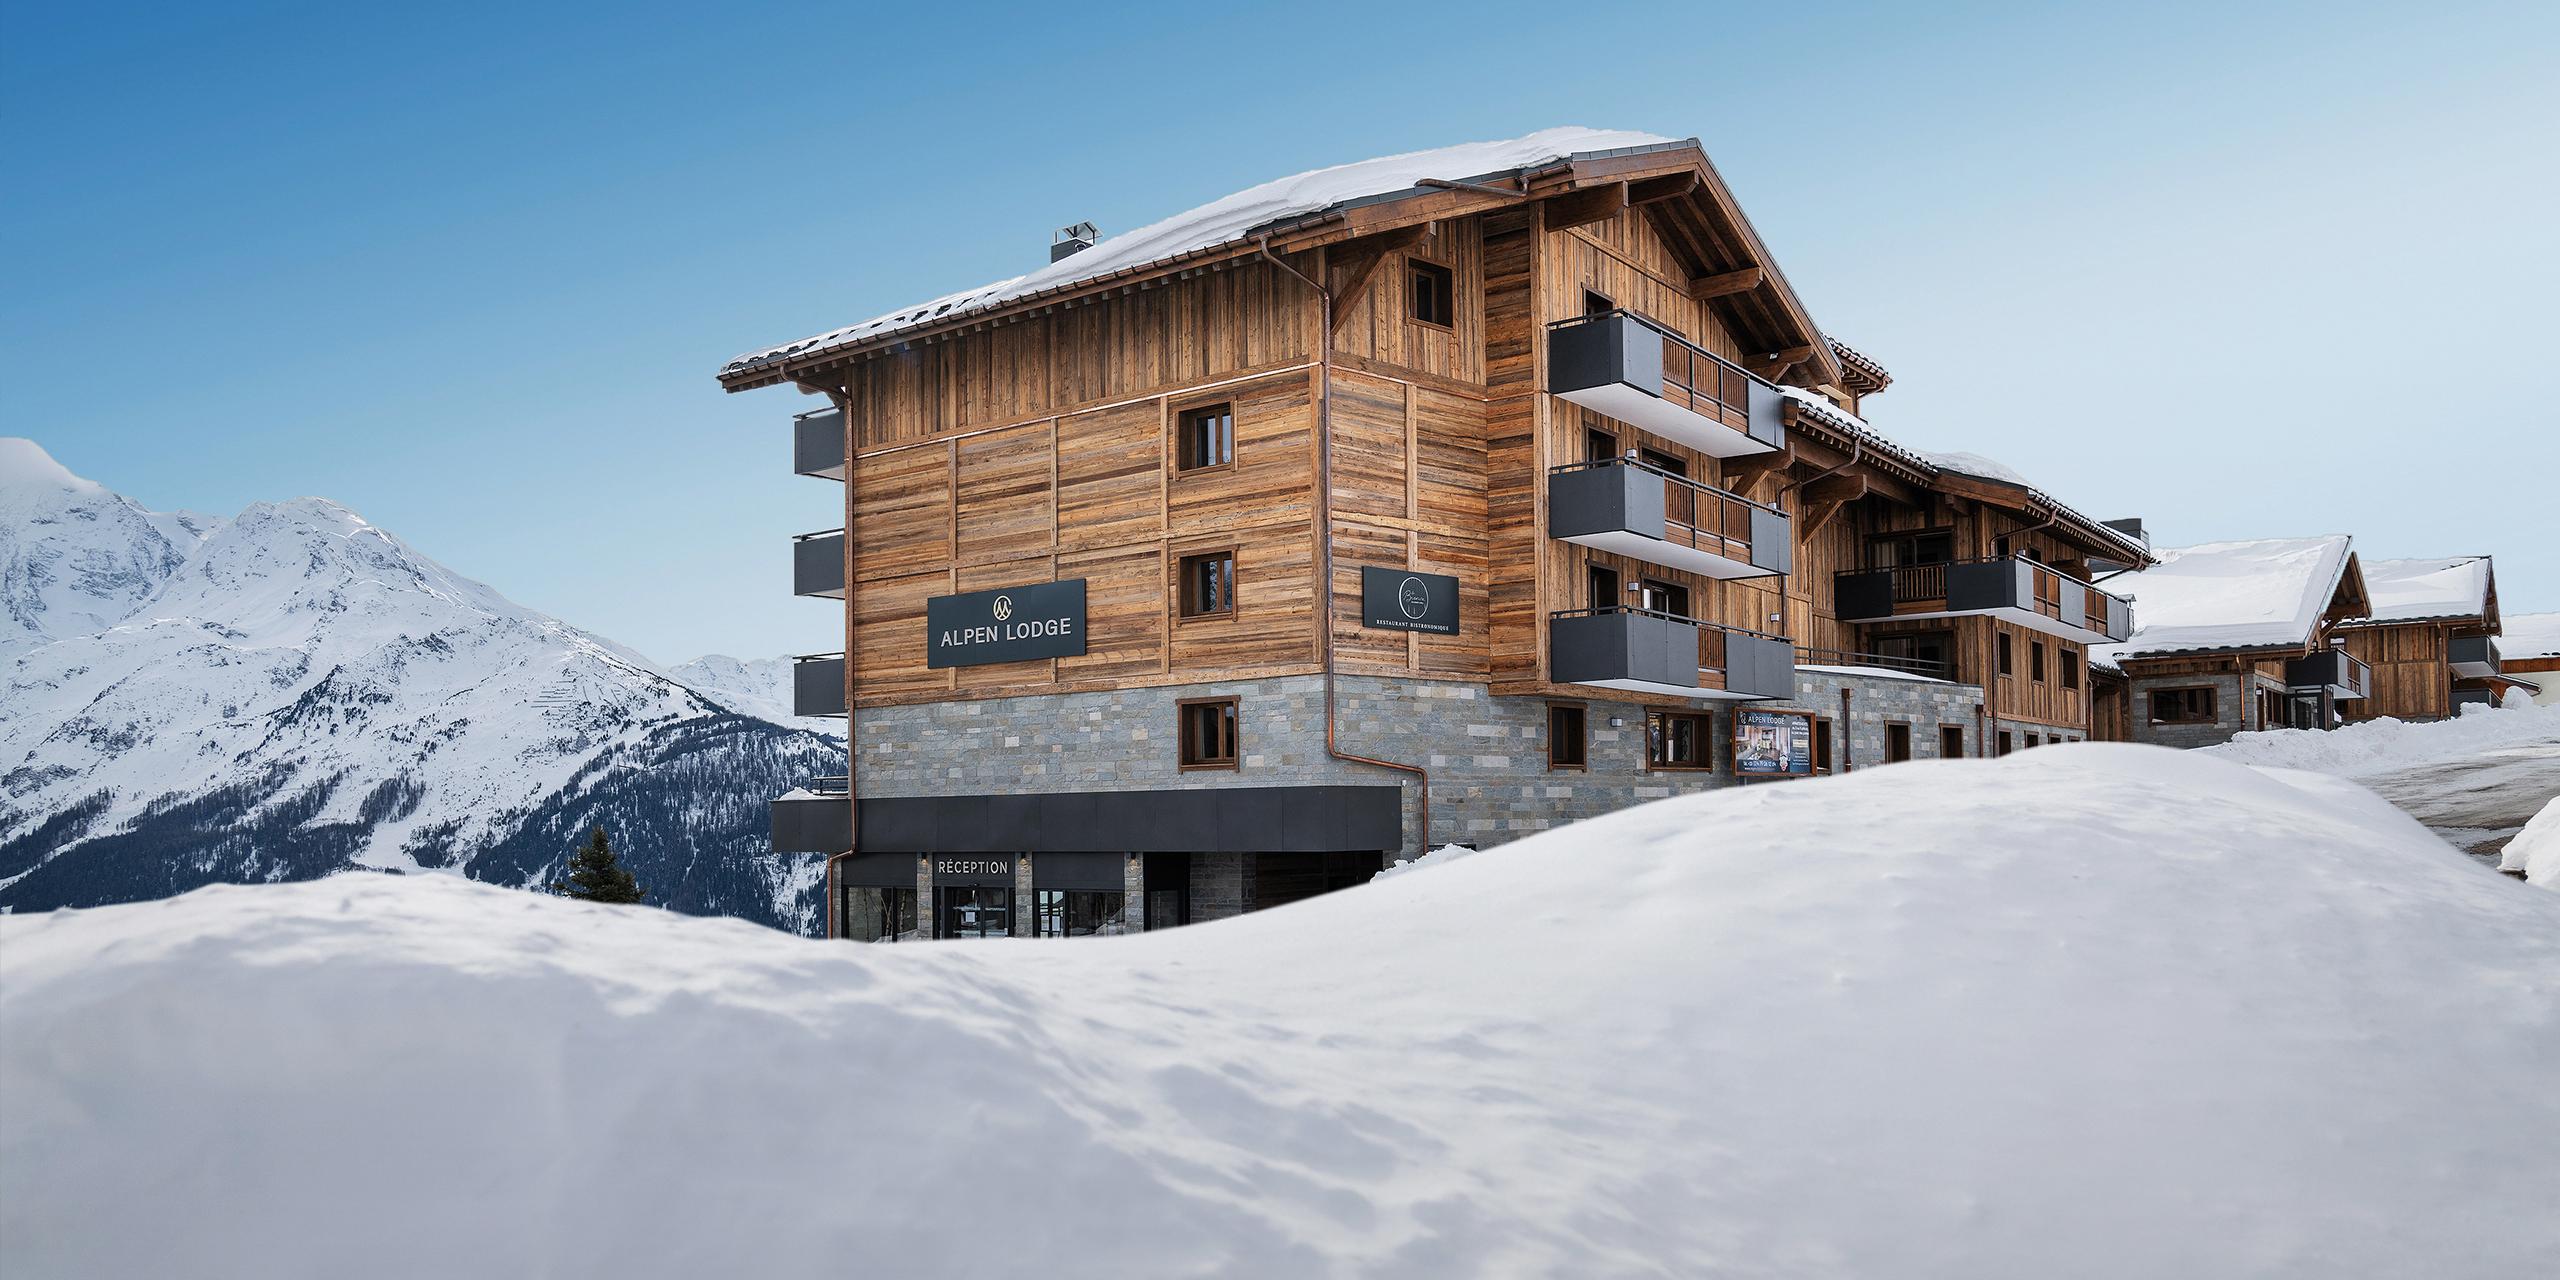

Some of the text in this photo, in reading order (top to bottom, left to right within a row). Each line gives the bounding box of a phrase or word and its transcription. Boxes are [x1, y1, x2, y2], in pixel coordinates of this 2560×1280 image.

[940, 617, 1072, 647] ALPEN LODGE
[1376, 619, 1449, 631] RESTAURANT BISTRONOMIQUE
[1748, 716, 1766, 724] ALPEN
[1767, 717, 1785, 725] LODGE
[938, 858, 1008, 874] RÉCEPTION
